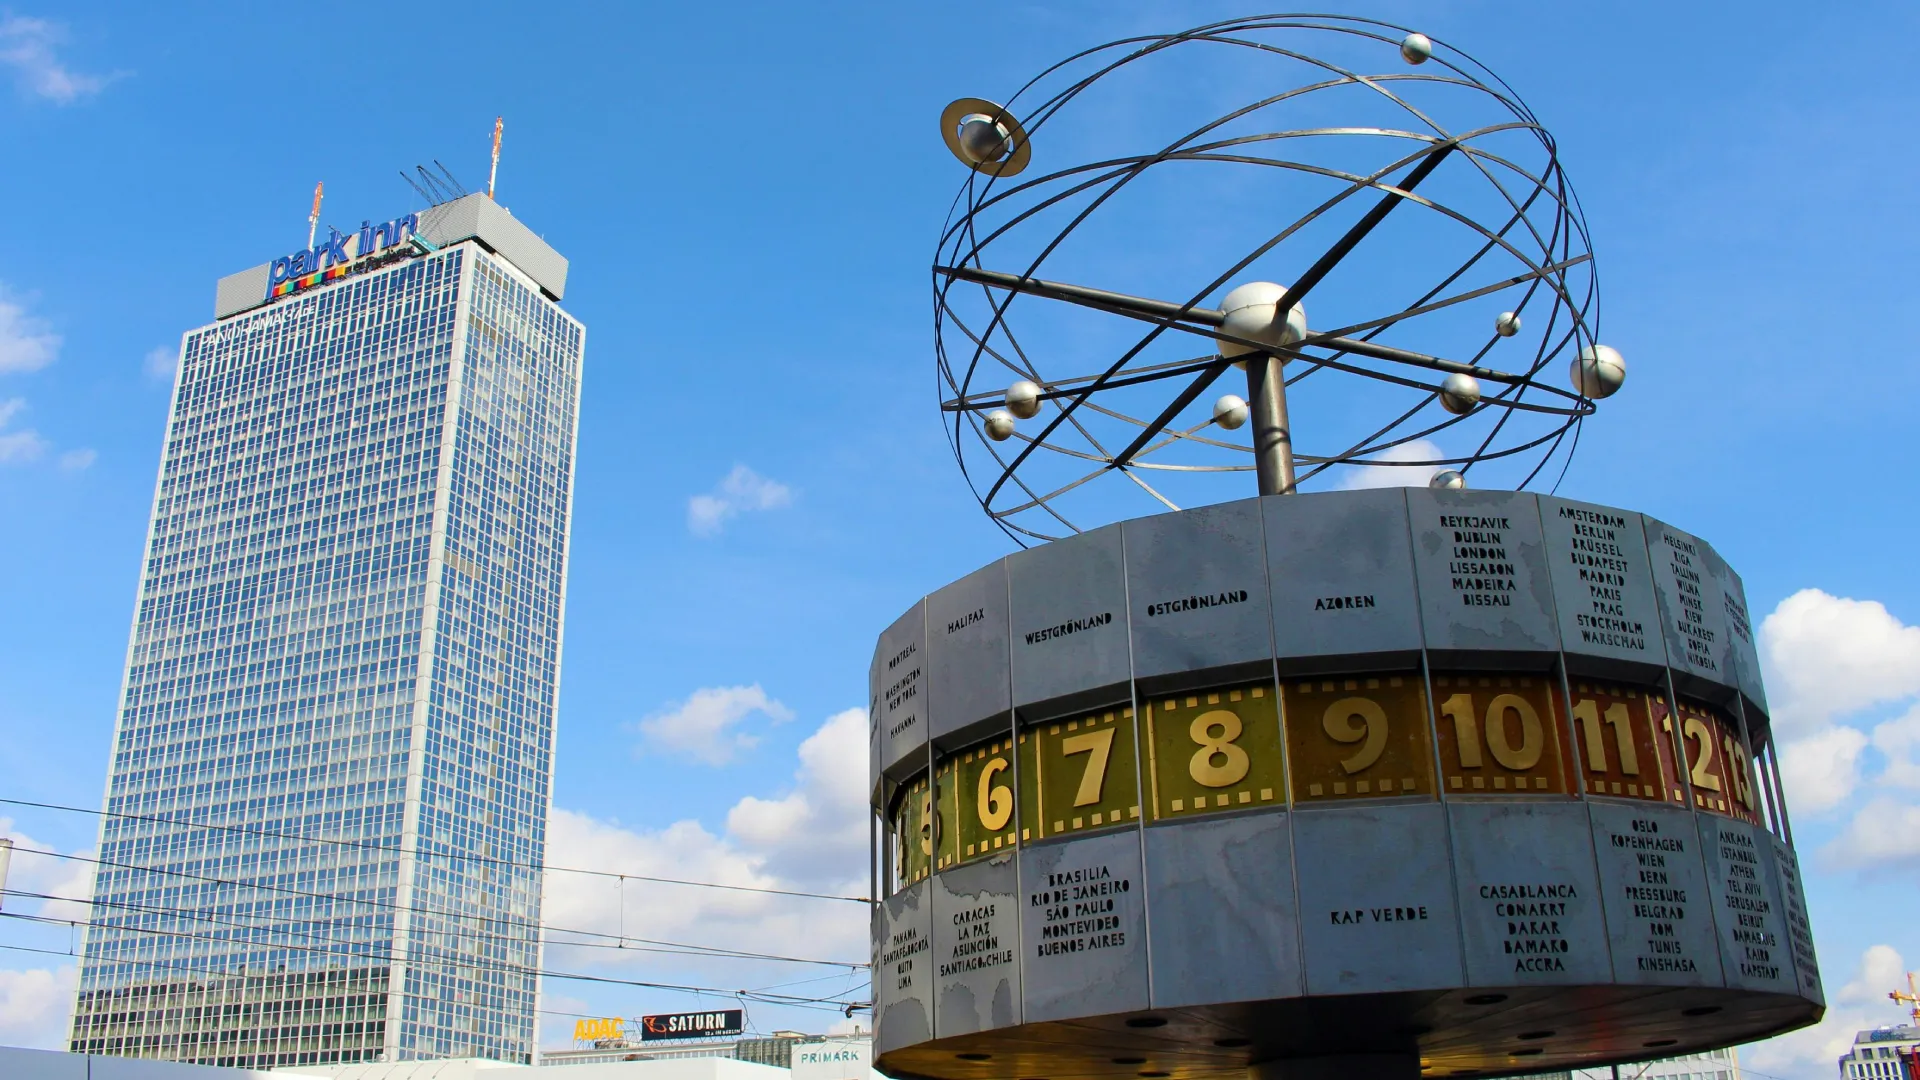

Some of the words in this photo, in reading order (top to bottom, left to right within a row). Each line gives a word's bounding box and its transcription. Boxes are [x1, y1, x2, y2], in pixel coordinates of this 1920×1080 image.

[265, 231, 352, 300] park
[356, 213, 418, 257] inn
[1440, 516, 1511, 529] REYKJAVIK
[1559, 507, 1626, 529] AMSTERDAM
[1455, 531, 1501, 544] DUBLIN
[1574, 524, 1615, 541] BERLIN
[1454, 547, 1506, 559] LONDON
[1572, 537, 1623, 557] BRÜSSEL
[1664, 534, 1696, 556] HELSINKI
[1571, 553, 1628, 572] BUDAPEST
[1674, 551, 1691, 567] RIGA
[1450, 562, 1515, 575] LISSABON
[1670, 563, 1700, 584] TALLINN
[1452, 578, 1516, 591] MADEIRA
[1579, 569, 1625, 587] MADRID
[1590, 586, 1621, 601] PARIS
[1676, 579, 1700, 597] WILNA
[1147, 590, 1248, 617] OSTGRÖNLAND
[1315, 595, 1375, 610] AZOREN
[1463, 594, 1510, 606] BISSAU
[1593, 601, 1624, 617] PRAG
[1679, 593, 1703, 612] MINSK
[948, 608, 985, 634] HALIFAX
[1577, 615, 1643, 634] STOCKHOLM
[1684, 609, 1702, 624] KIEW
[1025, 612, 1112, 645] WESTGRÖNLAND
[1677, 620, 1715, 643] BUKAREST
[1581, 630, 1645, 650] WARSCHAU
[1688, 639, 1710, 656] SOFIA
[889, 642, 916, 671] MONTREAL
[1687, 652, 1717, 671] NIKOSIA
[885, 666, 921, 700] WASHINGTON
[889, 695, 901, 712] NEW
[902, 684, 917, 703] YORK
[890, 713, 916, 739] HAVANNA
[1441, 693, 1544, 770] 10
[1322, 697, 1388, 774] 9
[1573, 698, 1639, 775] 11
[1189, 710, 1250, 787] 8
[1062, 728, 1116, 807] 7
[1724, 734, 1754, 811] 13
[977, 757, 1013, 831] 6
[1632, 820, 1658, 833] OSLO
[1611, 834, 1684, 852] KOPENHAGEN
[1720, 830, 1754, 848] ANKARA
[1636, 853, 1665, 867] WIEN
[1721, 846, 1757, 864] ISTANBUL
[1049, 866, 1110, 887] BRASILIA
[1640, 871, 1668, 884] BERN
[1730, 864, 1755, 880] ATHEN
[1032, 892, 1049, 906] RIO
[1054, 889, 1068, 901] DE
[1073, 880, 1130, 900] JANEIRO
[1480, 885, 1577, 899] CASABLANCA
[1626, 886, 1686, 903] PRESSBURG
[1728, 880, 1742, 893] TEL
[1744, 882, 1761, 896] AVIV
[1047, 904, 1069, 921] SÃO
[1075, 899, 1114, 916] PAULO
[1496, 903, 1566, 917] CONAKRY
[1634, 904, 1684, 920] BELGRAD
[1725, 895, 1770, 914] JERUSALEM
[954, 904, 995, 925] CARACAS
[1331, 911, 1364, 925] KAP
[1371, 907, 1428, 922] VERDE
[1738, 914, 1763, 928] BEIRUT
[958, 927, 970, 940] LA
[973, 921, 990, 937] PAZ
[1043, 915, 1120, 940] MONTEVIDEO
[1508, 921, 1560, 935] DAKAR
[1651, 922, 1674, 936] ROM
[953, 934, 998, 958] ASUNCIÓN
[1038, 940, 1084, 957] BUENOS
[1089, 932, 1125, 951] AIRES
[1504, 939, 1568, 955] BAMAKO
[1648, 940, 1681, 955] TUNIS
[1745, 947, 1770, 962] KAIRO
[898, 959, 912, 974] QUITO
[1515, 958, 1565, 973] ACCRA
[1637, 957, 1697, 972] KINSHASA
[1740, 963, 1780, 980] KAPSTADT
[898, 975, 912, 990] LIMA
[573, 1017, 624, 1041] ADAC
[669, 1013, 725, 1032] SATURN
[801, 1051, 859, 1063] PRIMARK
